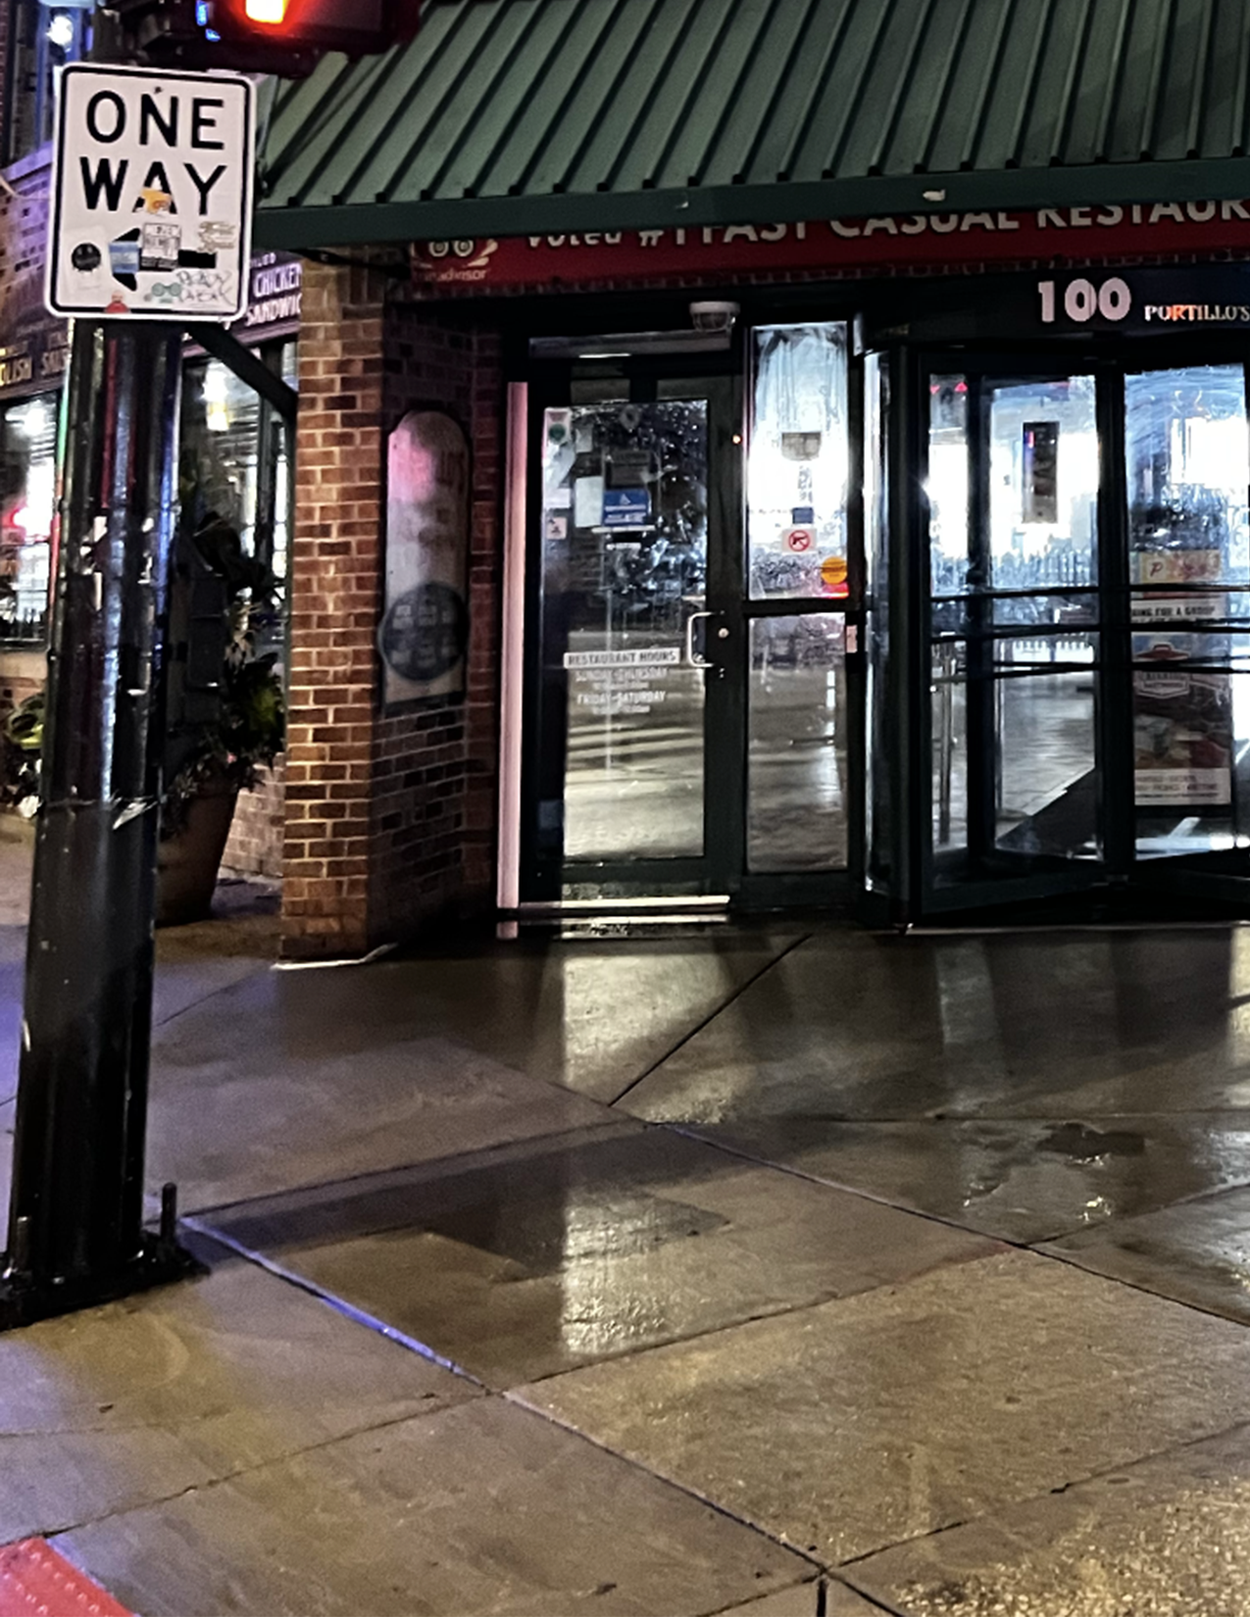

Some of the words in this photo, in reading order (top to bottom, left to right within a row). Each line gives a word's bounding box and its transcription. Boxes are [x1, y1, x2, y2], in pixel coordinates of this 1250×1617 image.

[86, 90, 224, 150] ONE
[80, 156, 227, 216] WAY
[1038, 277, 1132, 323] 100
[1144, 304, 1250, 322] PORTILLO'S
[568, 653, 637, 666] RESTAURANT
[639, 649, 677, 663] HOURS
